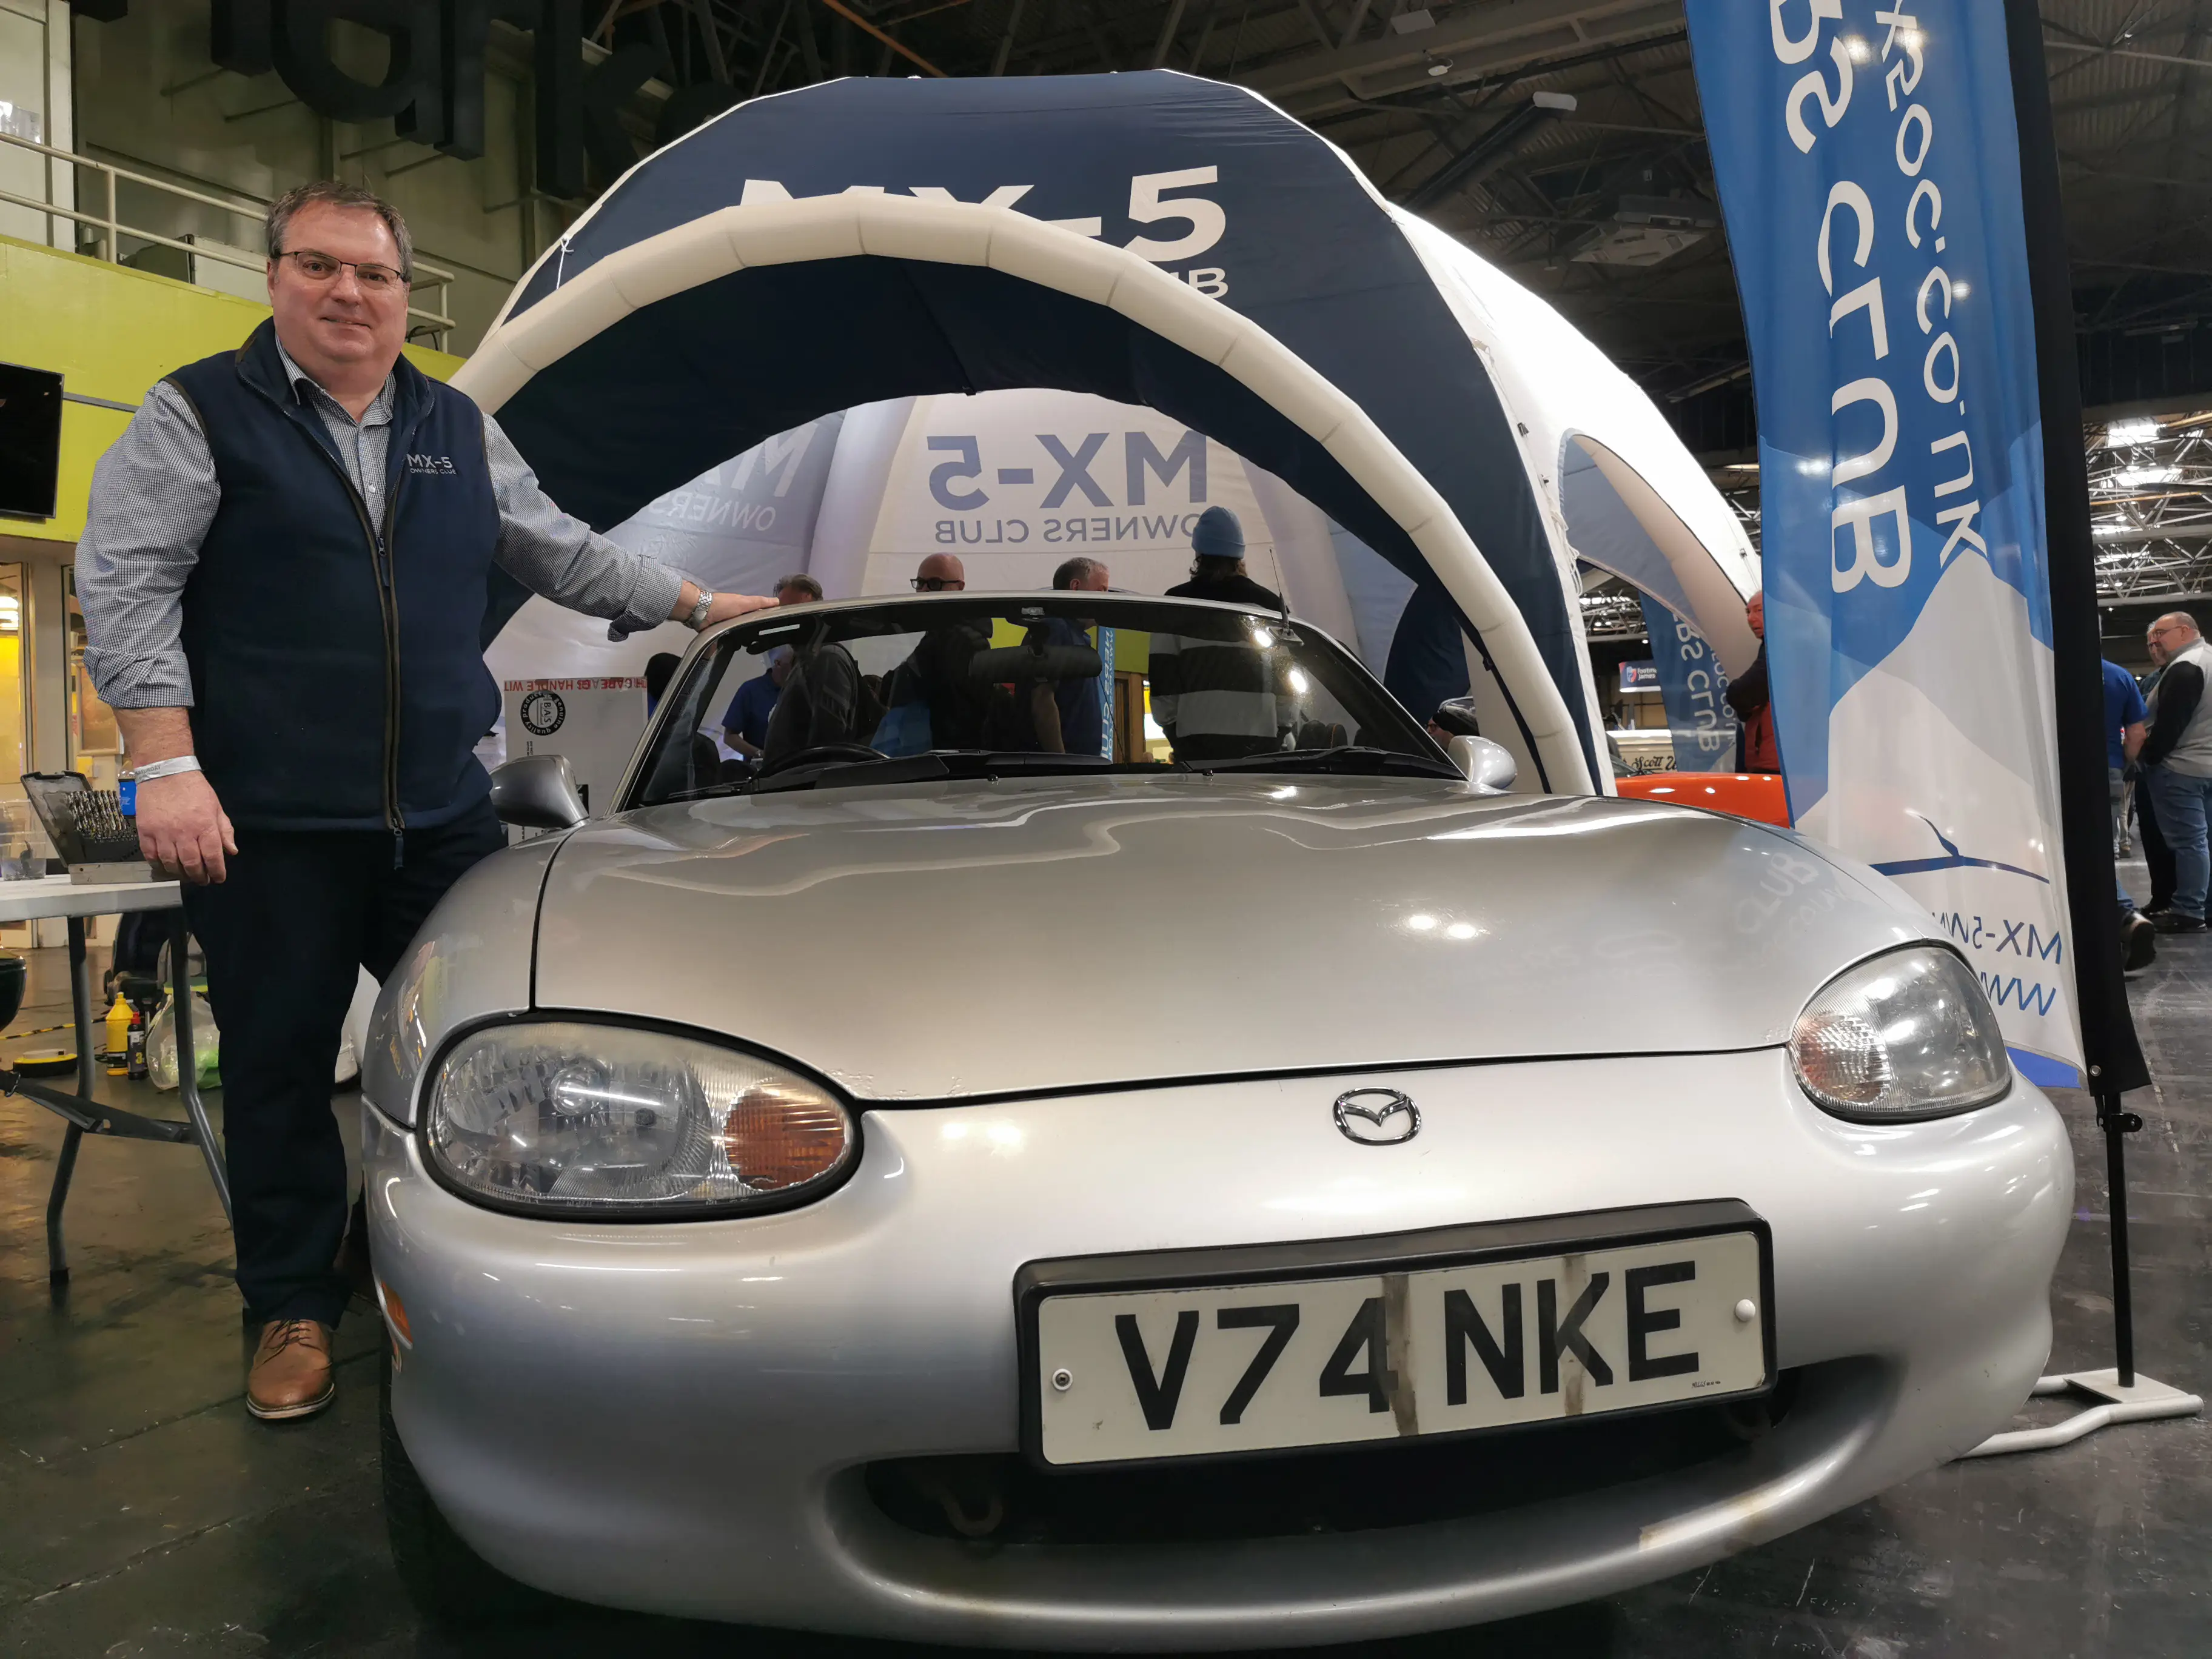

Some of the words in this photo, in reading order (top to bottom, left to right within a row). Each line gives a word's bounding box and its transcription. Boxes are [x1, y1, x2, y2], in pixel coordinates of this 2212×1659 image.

[406, 454, 453, 469] MX-5
[527, 679, 574, 691] HANDLE
[1114, 1296, 1399, 1431] V74
[1443, 1260, 1700, 1407] NKE
